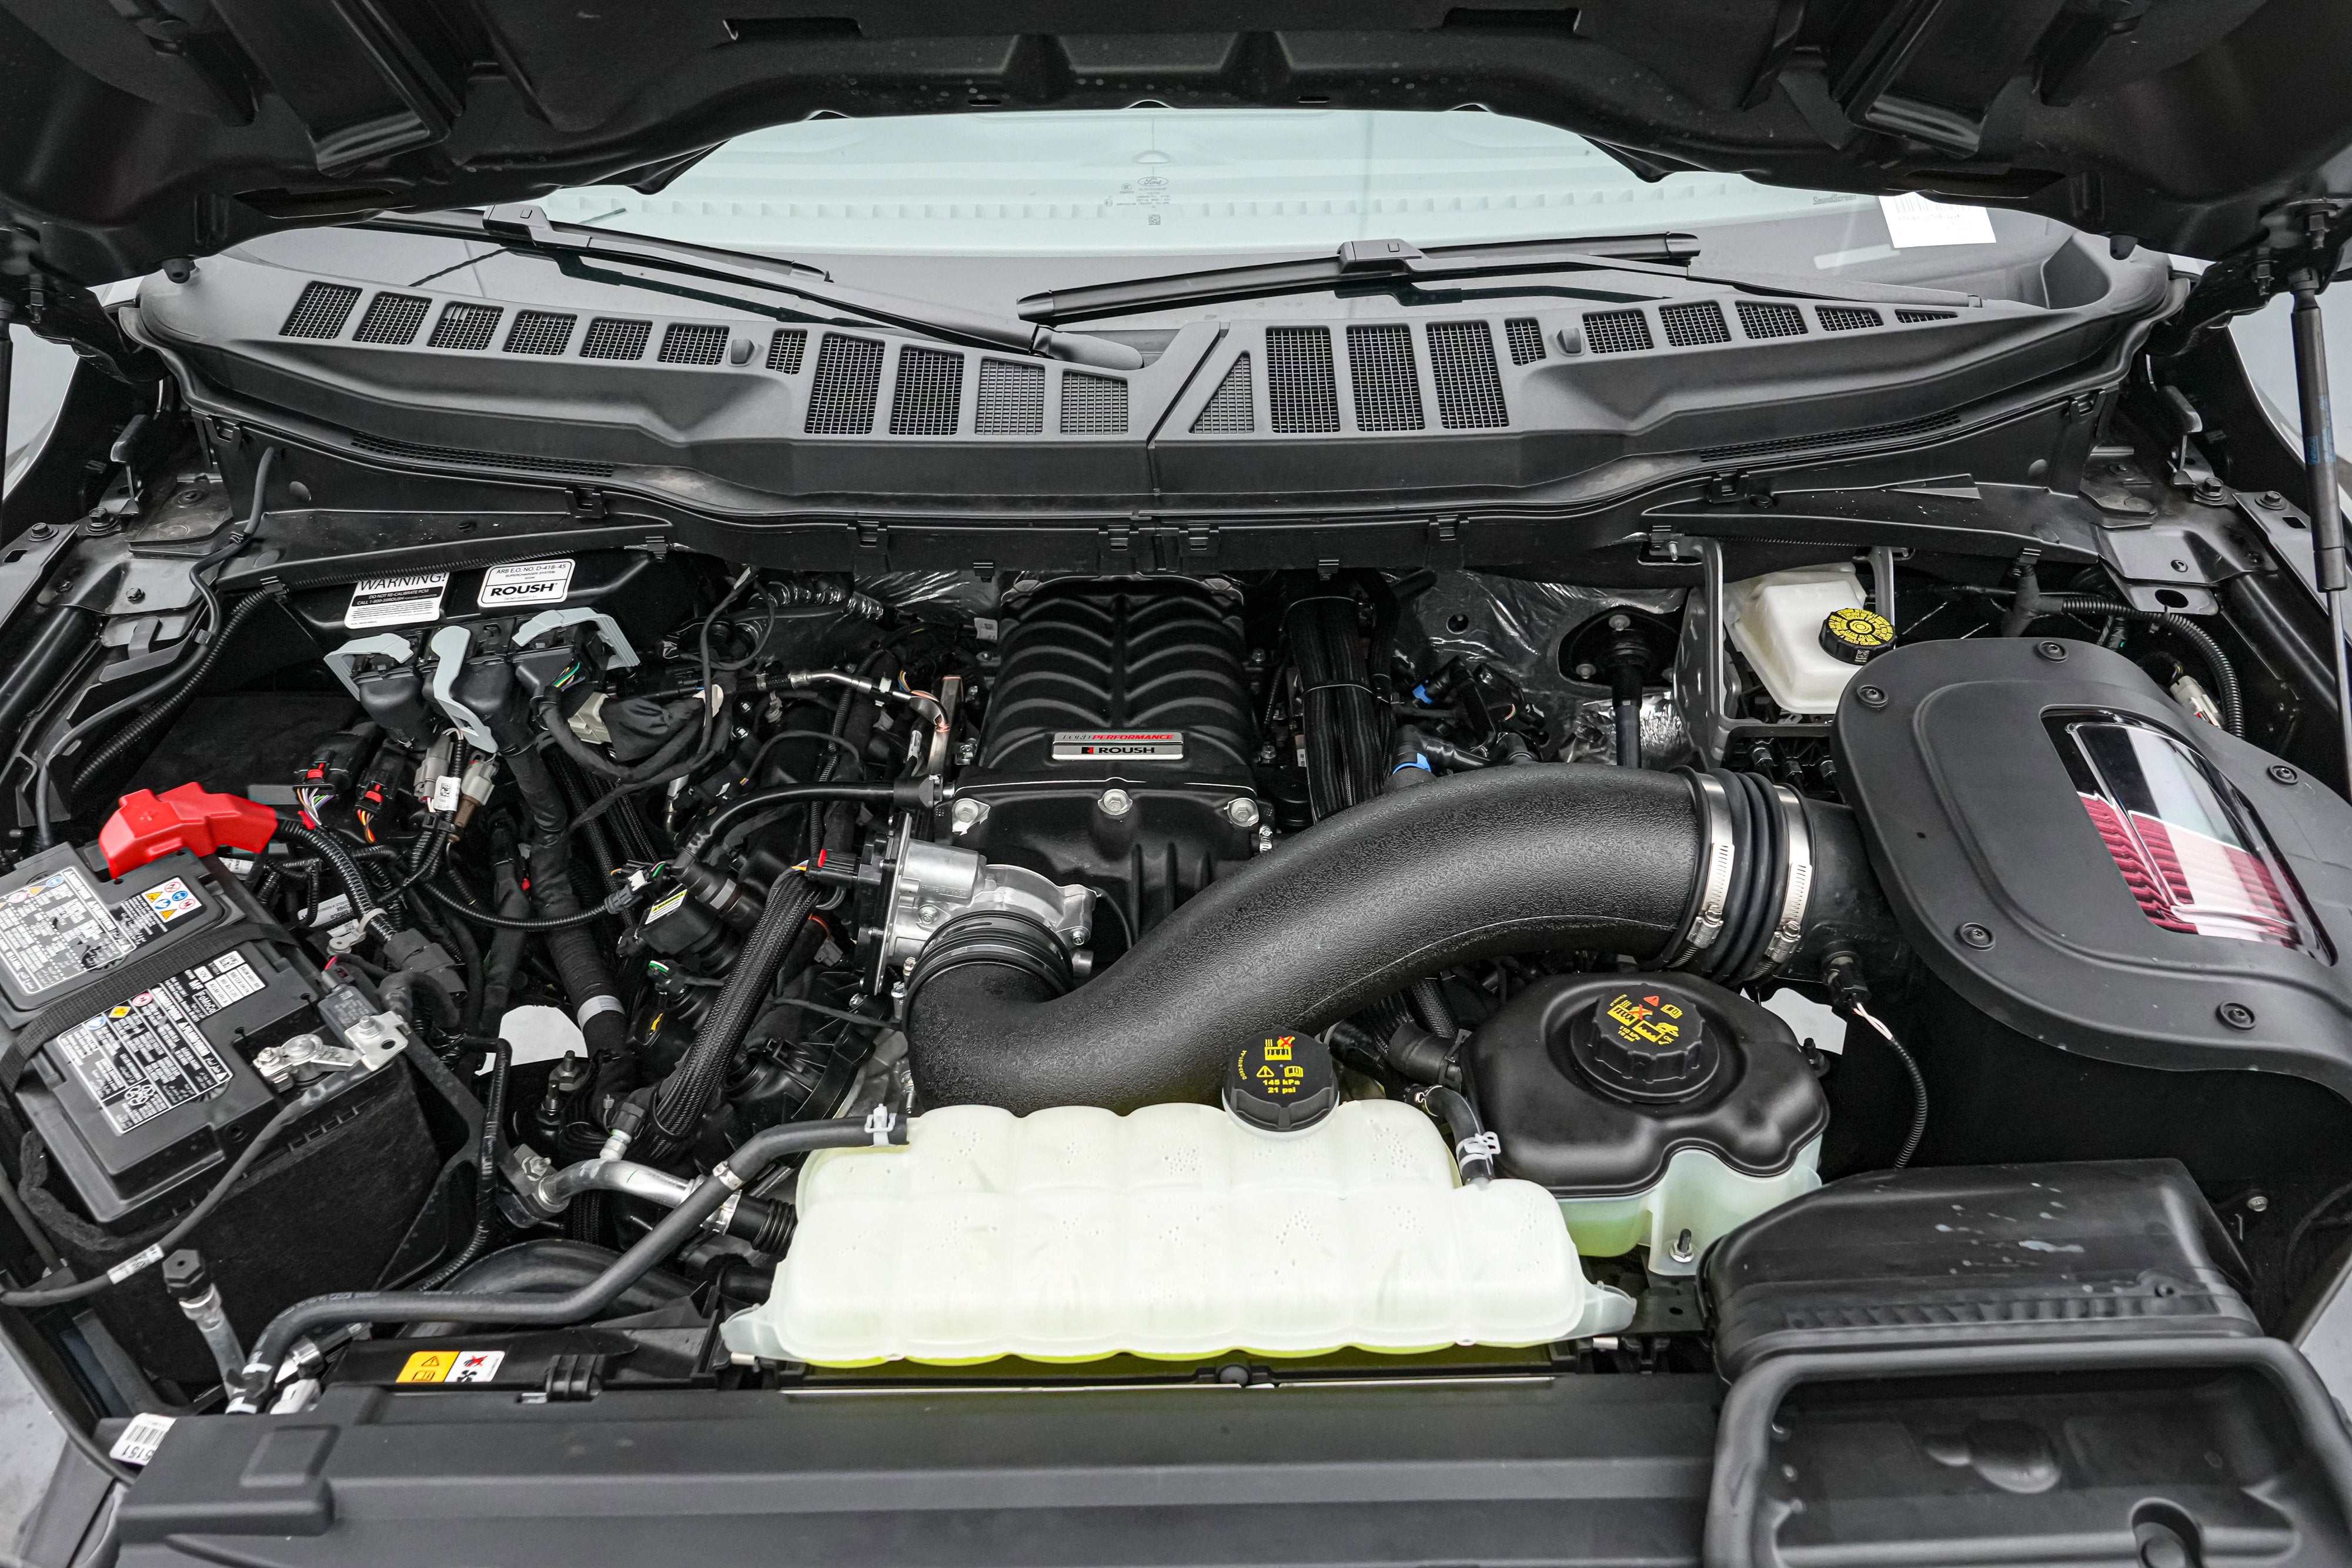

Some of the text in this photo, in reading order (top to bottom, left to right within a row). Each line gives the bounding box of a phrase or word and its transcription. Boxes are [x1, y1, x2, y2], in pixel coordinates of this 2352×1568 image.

[1813, 195, 1856, 205] SoundScreen
[490, 583, 554, 596] ROUSH
[188, 978, 203, 992] MF
[196, 991, 218, 1014] FoMoCo
